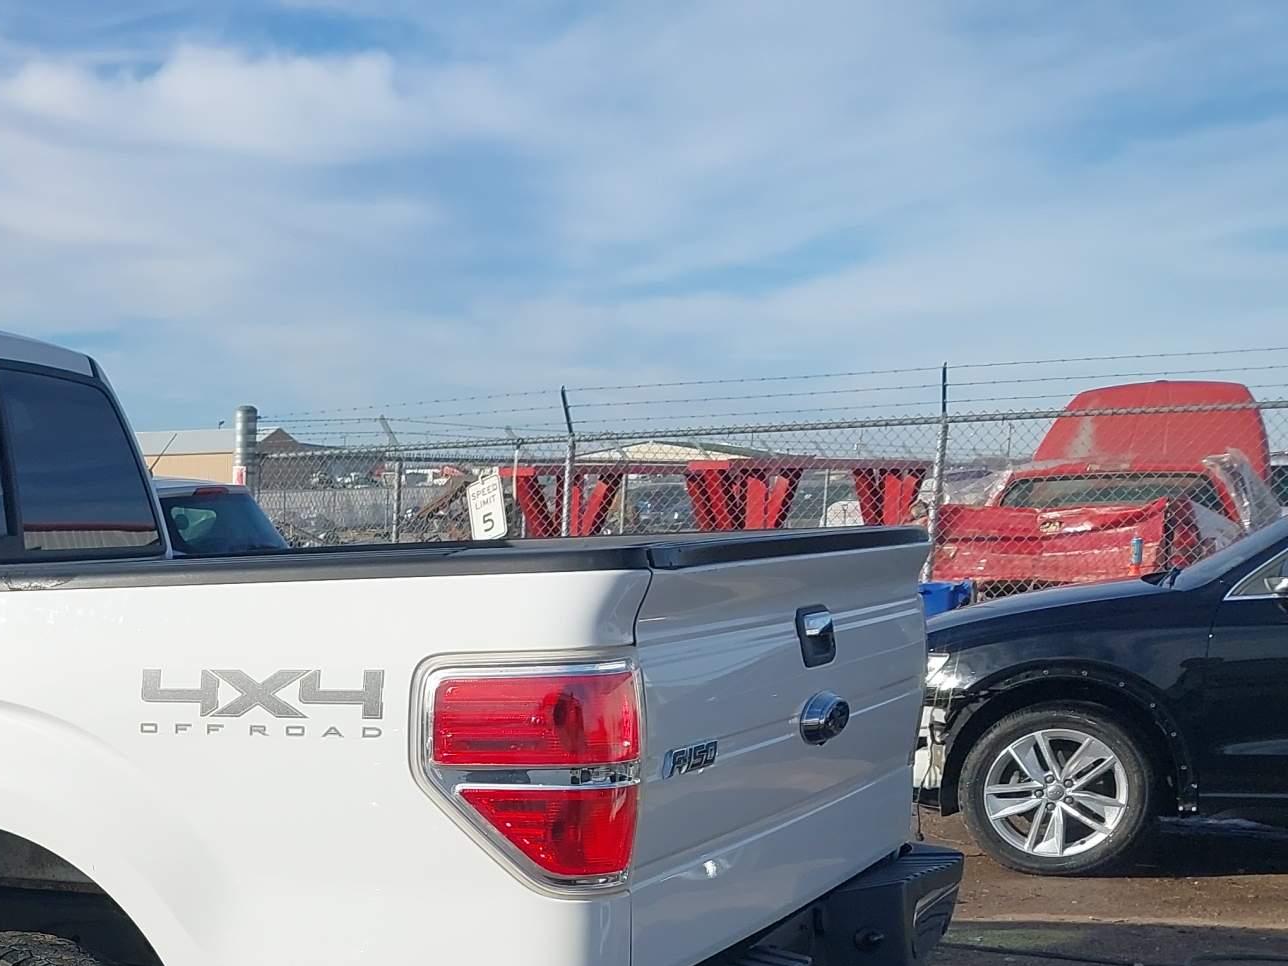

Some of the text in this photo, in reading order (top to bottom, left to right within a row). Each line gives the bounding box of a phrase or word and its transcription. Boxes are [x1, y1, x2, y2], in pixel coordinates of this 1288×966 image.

[471, 483, 498, 501] SPEED
[475, 493, 497, 510] LIMIT
[482, 511, 495, 533] 5
